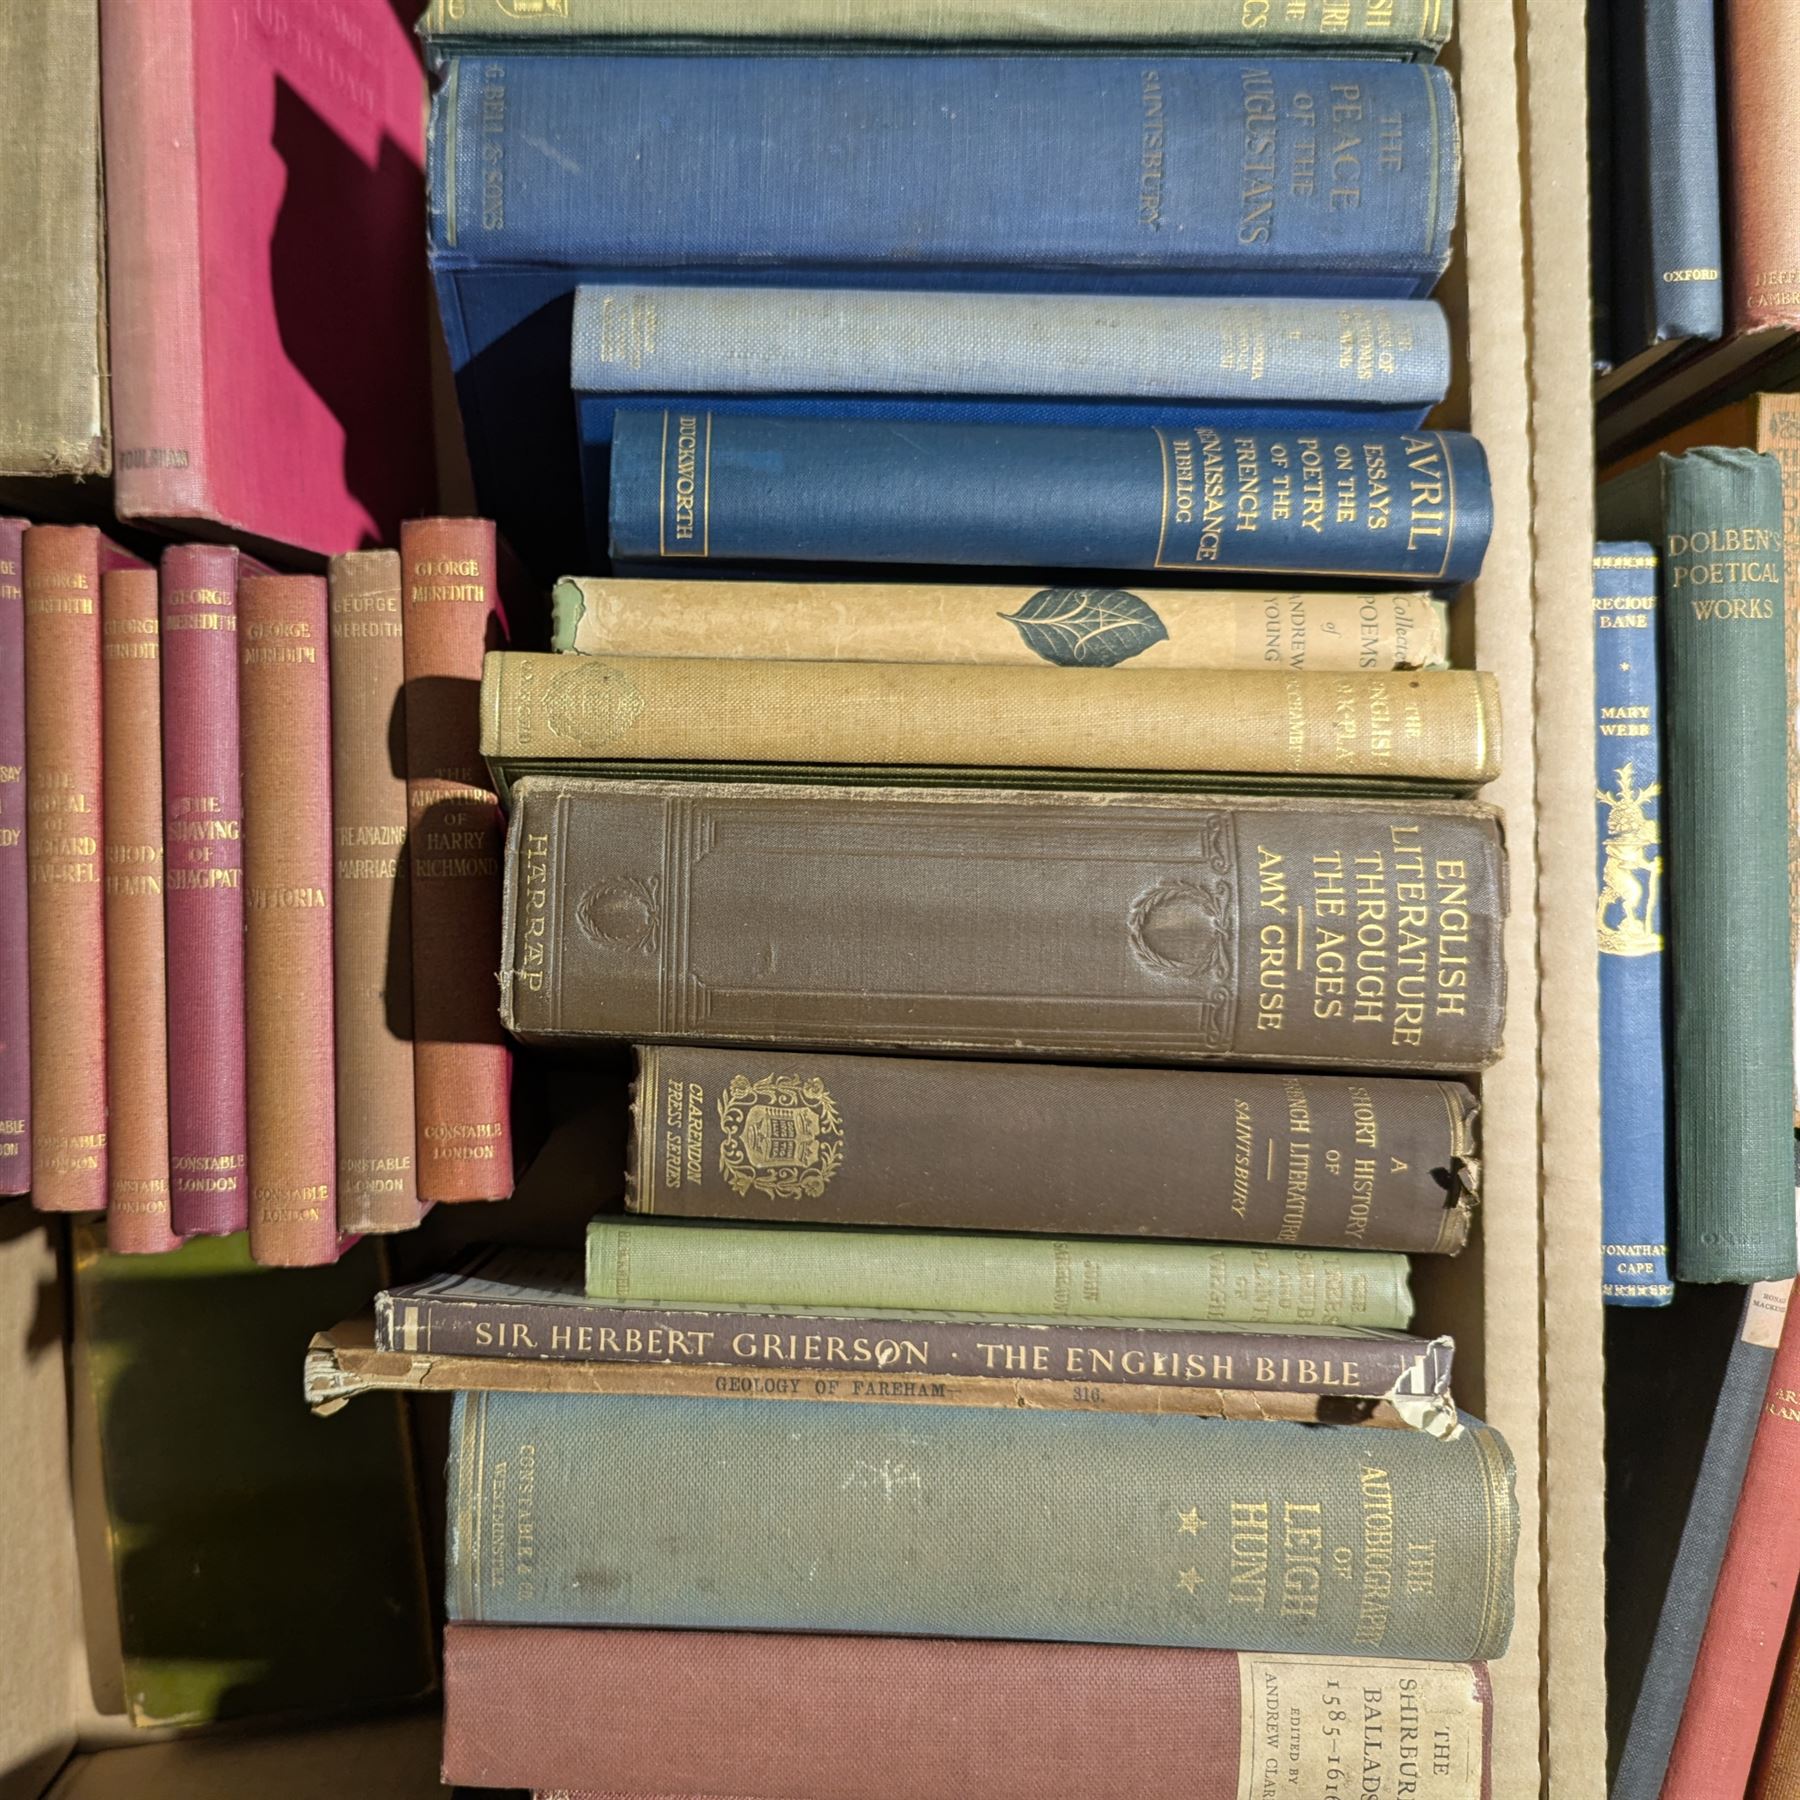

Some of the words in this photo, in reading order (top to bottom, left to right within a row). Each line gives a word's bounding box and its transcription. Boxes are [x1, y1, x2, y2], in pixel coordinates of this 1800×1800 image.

[1292, 92, 1316, 127] OF
[1139, 69, 1165, 228] SAINTSBURY
[1239, 66, 1276, 247] AUGUSTANS
[1329, 84, 1363, 212] PEACE
[1375, 112, 1404, 172] THE
[1291, 136, 1316, 198] THE
[482, 170, 505, 231] SONS
[1663, 268, 1718, 283] OXFORD
[676, 416, 697, 541] DUCKWORTH
[1270, 444, 1288, 469] OF
[1333, 444, 1353, 471] ON
[1194, 428, 1223, 561] RENAISSANCE
[1234, 437, 1260, 532] FRENCH
[1271, 475, 1291, 521] THE
[1297, 438, 1326, 534] POETRY
[1337, 477, 1356, 523] THE
[1362, 444, 1390, 530] ESSAYS
[1400, 436, 1444, 551] AVRIL
[415, 560, 479, 577] GEORGE
[1673, 562, 1780, 587] POETICAL
[171, 588, 231, 605] GEORGE
[334, 598, 397, 612] GEORGE
[411, 585, 484, 602] MEREDITH
[1692, 598, 1774, 620] WORKS
[167, 614, 236, 632] MEREDITH
[249, 623, 311, 639] GEORGE
[333, 622, 402, 638] MEREDITH
[1264, 597, 1281, 662] YOUNG
[1289, 592, 1305, 670] ANDREW
[1320, 622, 1341, 636] of
[1357, 595, 1379, 668] POEMS
[1600, 615, 1648, 628] BANE
[1405, 704, 1421, 738] THE
[1600, 724, 1651, 737] WEBB
[1601, 707, 1650, 719] MARY
[434, 767, 474, 781] THE
[181, 797, 221, 813] THE
[444, 812, 469, 826] OF
[189, 846, 214, 862] OF
[356, 824, 405, 846] AMAZING
[427, 831, 485, 851] HARRY
[167, 868, 241, 889] SHAGPAT
[416, 858, 498, 878] RICHMOND
[1257, 845, 1288, 916] AMY
[1312, 850, 1345, 918] THE
[523, 833, 548, 993] HARRAP
[1389, 825, 1428, 1047] LITERATURE
[1352, 850, 1386, 1024] THROUGH
[1435, 860, 1468, 1017] ENGLISH
[1257, 924, 1286, 1032] CRUSE
[1313, 926, 1345, 1020] AGES
[667, 1079, 683, 1128] PRESS
[1282, 1079, 1311, 1133] FRENCH
[1347, 1086, 1376, 1148] SHORT
[424, 1122, 502, 1139] CONSTABLE
[433, 1145, 495, 1160] LONDON
[686, 1082, 704, 1186] CLARENDON
[172, 1153, 244, 1171] CONSTABLE
[665, 1131, 683, 1189] SERIES
[1230, 1099, 1254, 1220] SAINTSBURY
[1324, 1149, 1340, 1175] OF
[1390, 1156, 1408, 1174] A
[178, 1176, 238, 1192] LONDON
[254, 1185, 329, 1201] CONSTABLE
[346, 1179, 404, 1193] LONDON
[1275, 1142, 1310, 1241] LITERATURE
[1344, 1159, 1375, 1240] HISTORY
[262, 1207, 319, 1224] LONDON
[1617, 1262, 1654, 1274] CAPE
[475, 1322, 538, 1348] SIR
[550, 1325, 714, 1356] HERBERT
[732, 1333, 929, 1365] GRIERSON
[976, 1343, 1050, 1371] THE
[1066, 1347, 1234, 1380] ENGLISH
[1255, 1357, 1361, 1387] BIBLE
[715, 1375, 800, 1393] GEOLOGY
[814, 1379, 840, 1395] OF
[517, 1444, 535, 1558] CONSTABLE
[1229, 1501, 1268, 1615] HUNT
[1281, 1500, 1321, 1618] LEIGH
[1333, 1546, 1353, 1580] OF
[1406, 1541, 1437, 1597] THE
[1264, 1672, 1280, 1749] ANDREW
[1289, 1706, 1302, 1761] EDITED
[1360, 1687, 1382, 1800] BALLADS
[1432, 1726, 1450, 1776] THE
[1287, 1768, 1300, 1785] BY
